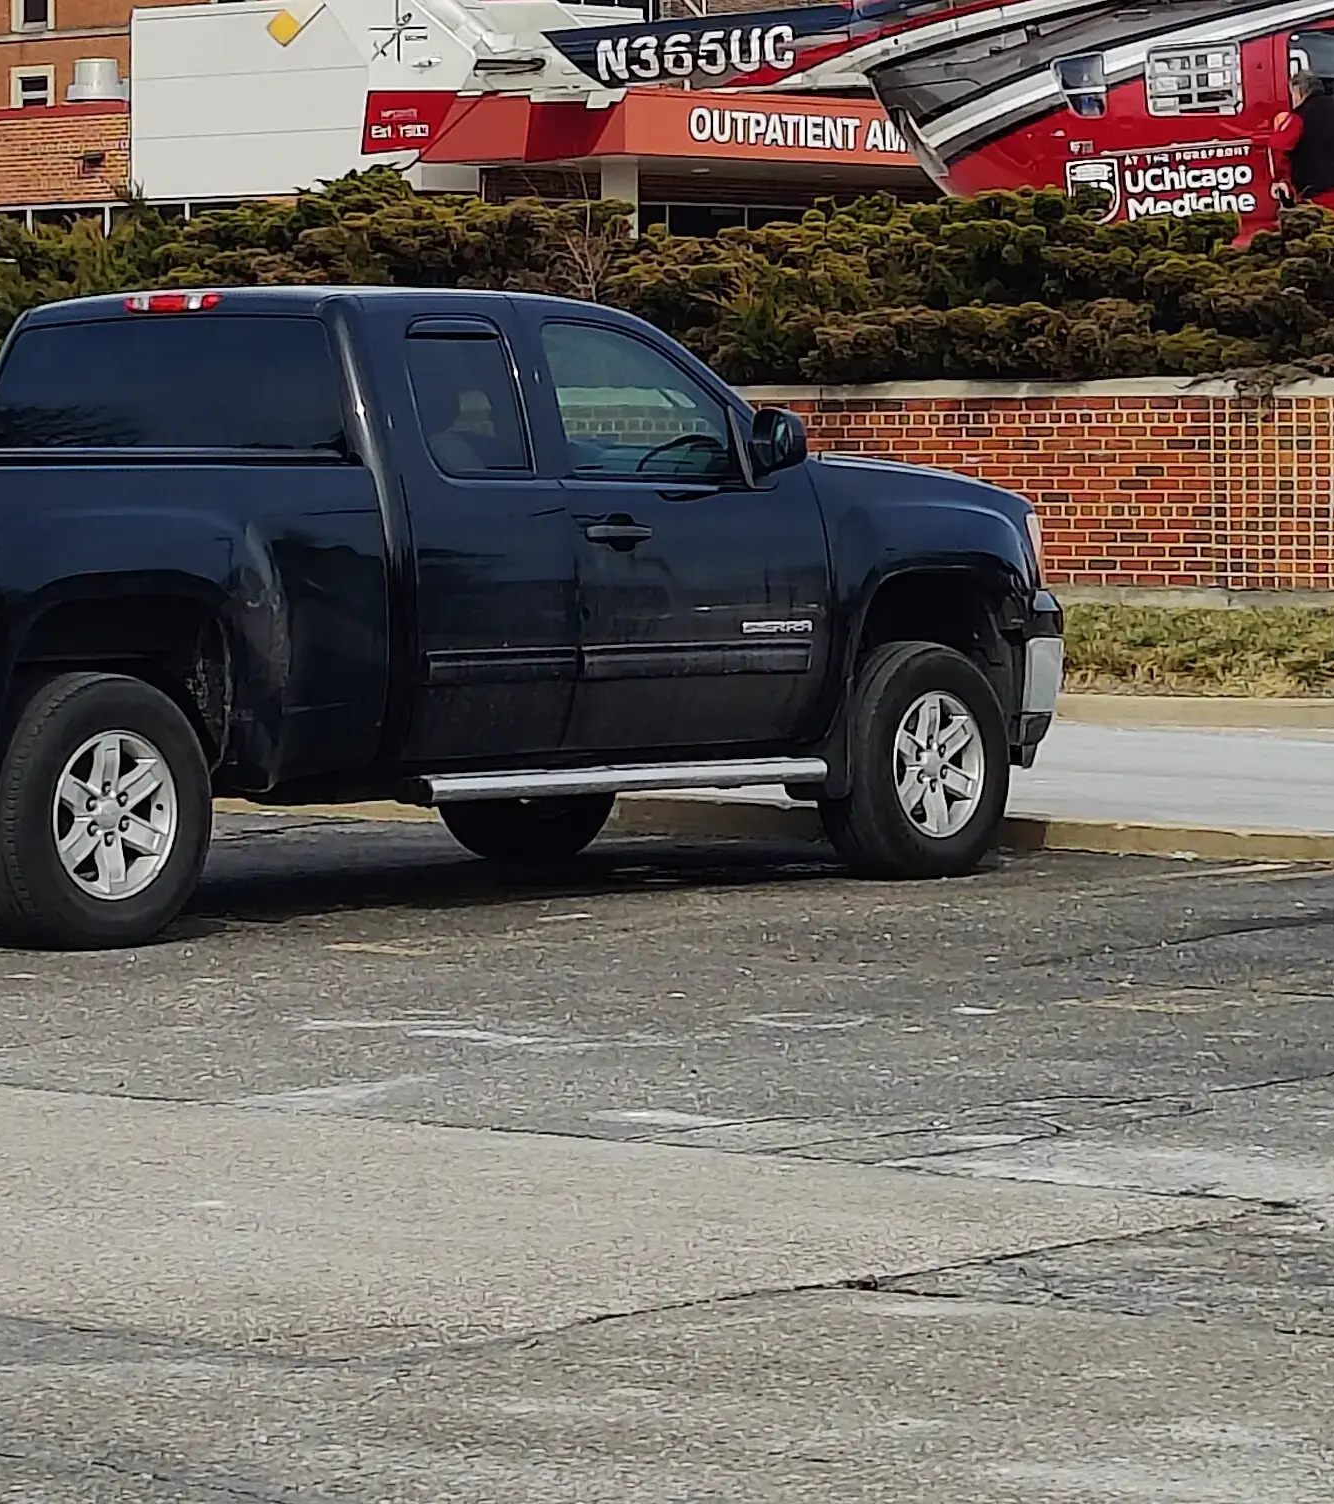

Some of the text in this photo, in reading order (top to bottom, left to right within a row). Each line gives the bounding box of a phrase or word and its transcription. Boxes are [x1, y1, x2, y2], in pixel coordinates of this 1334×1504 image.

[596, 25, 795, 81] N365UC
[689, 107, 909, 153] OUTPATIENT AM
[1125, 164, 1252, 194] UChicago
[1127, 188, 1256, 221] Medicine
